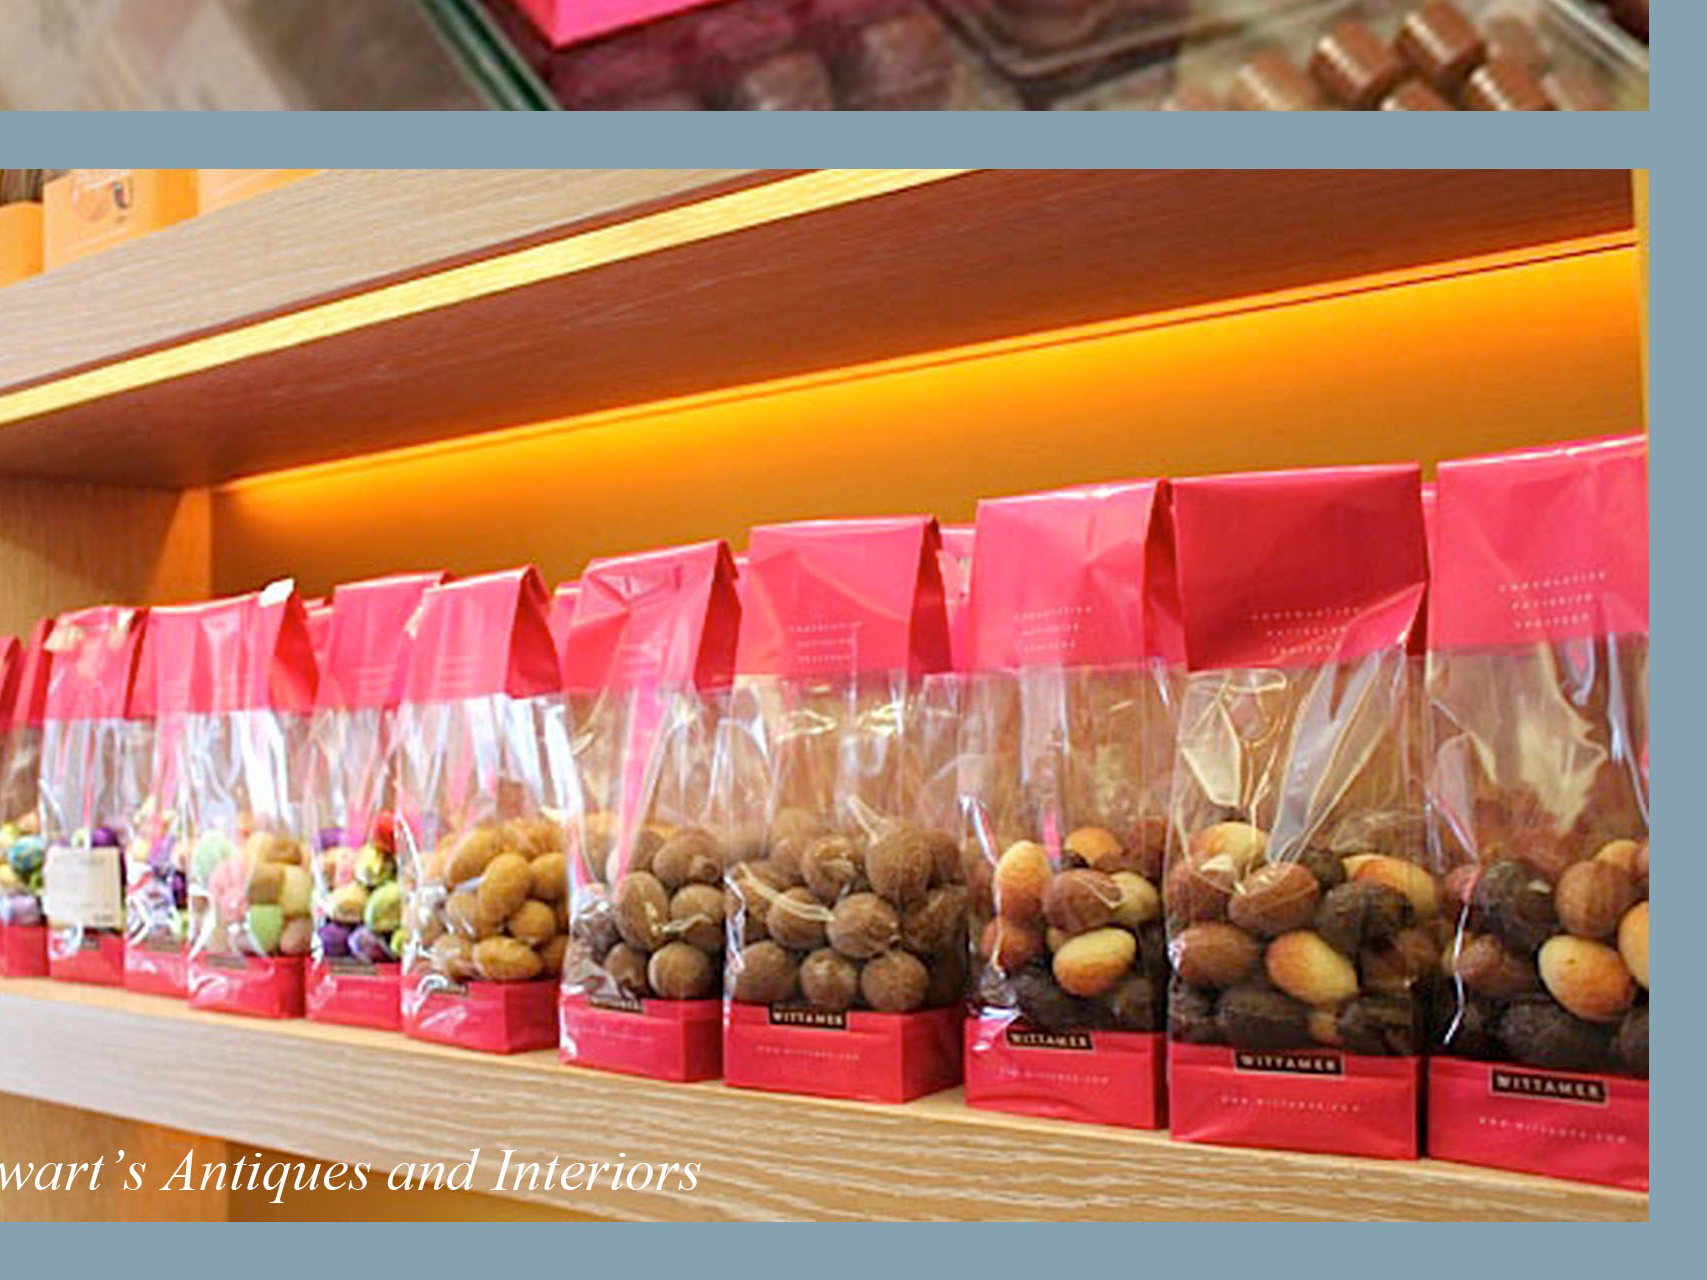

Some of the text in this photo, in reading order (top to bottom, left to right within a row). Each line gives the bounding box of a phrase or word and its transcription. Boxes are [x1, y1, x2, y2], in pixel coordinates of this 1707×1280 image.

[1009, 1032, 1088, 1048] WITTAMER
[1240, 1054, 1336, 1072] WITTAMER
[1495, 1073, 1601, 1098] WITTAMER
